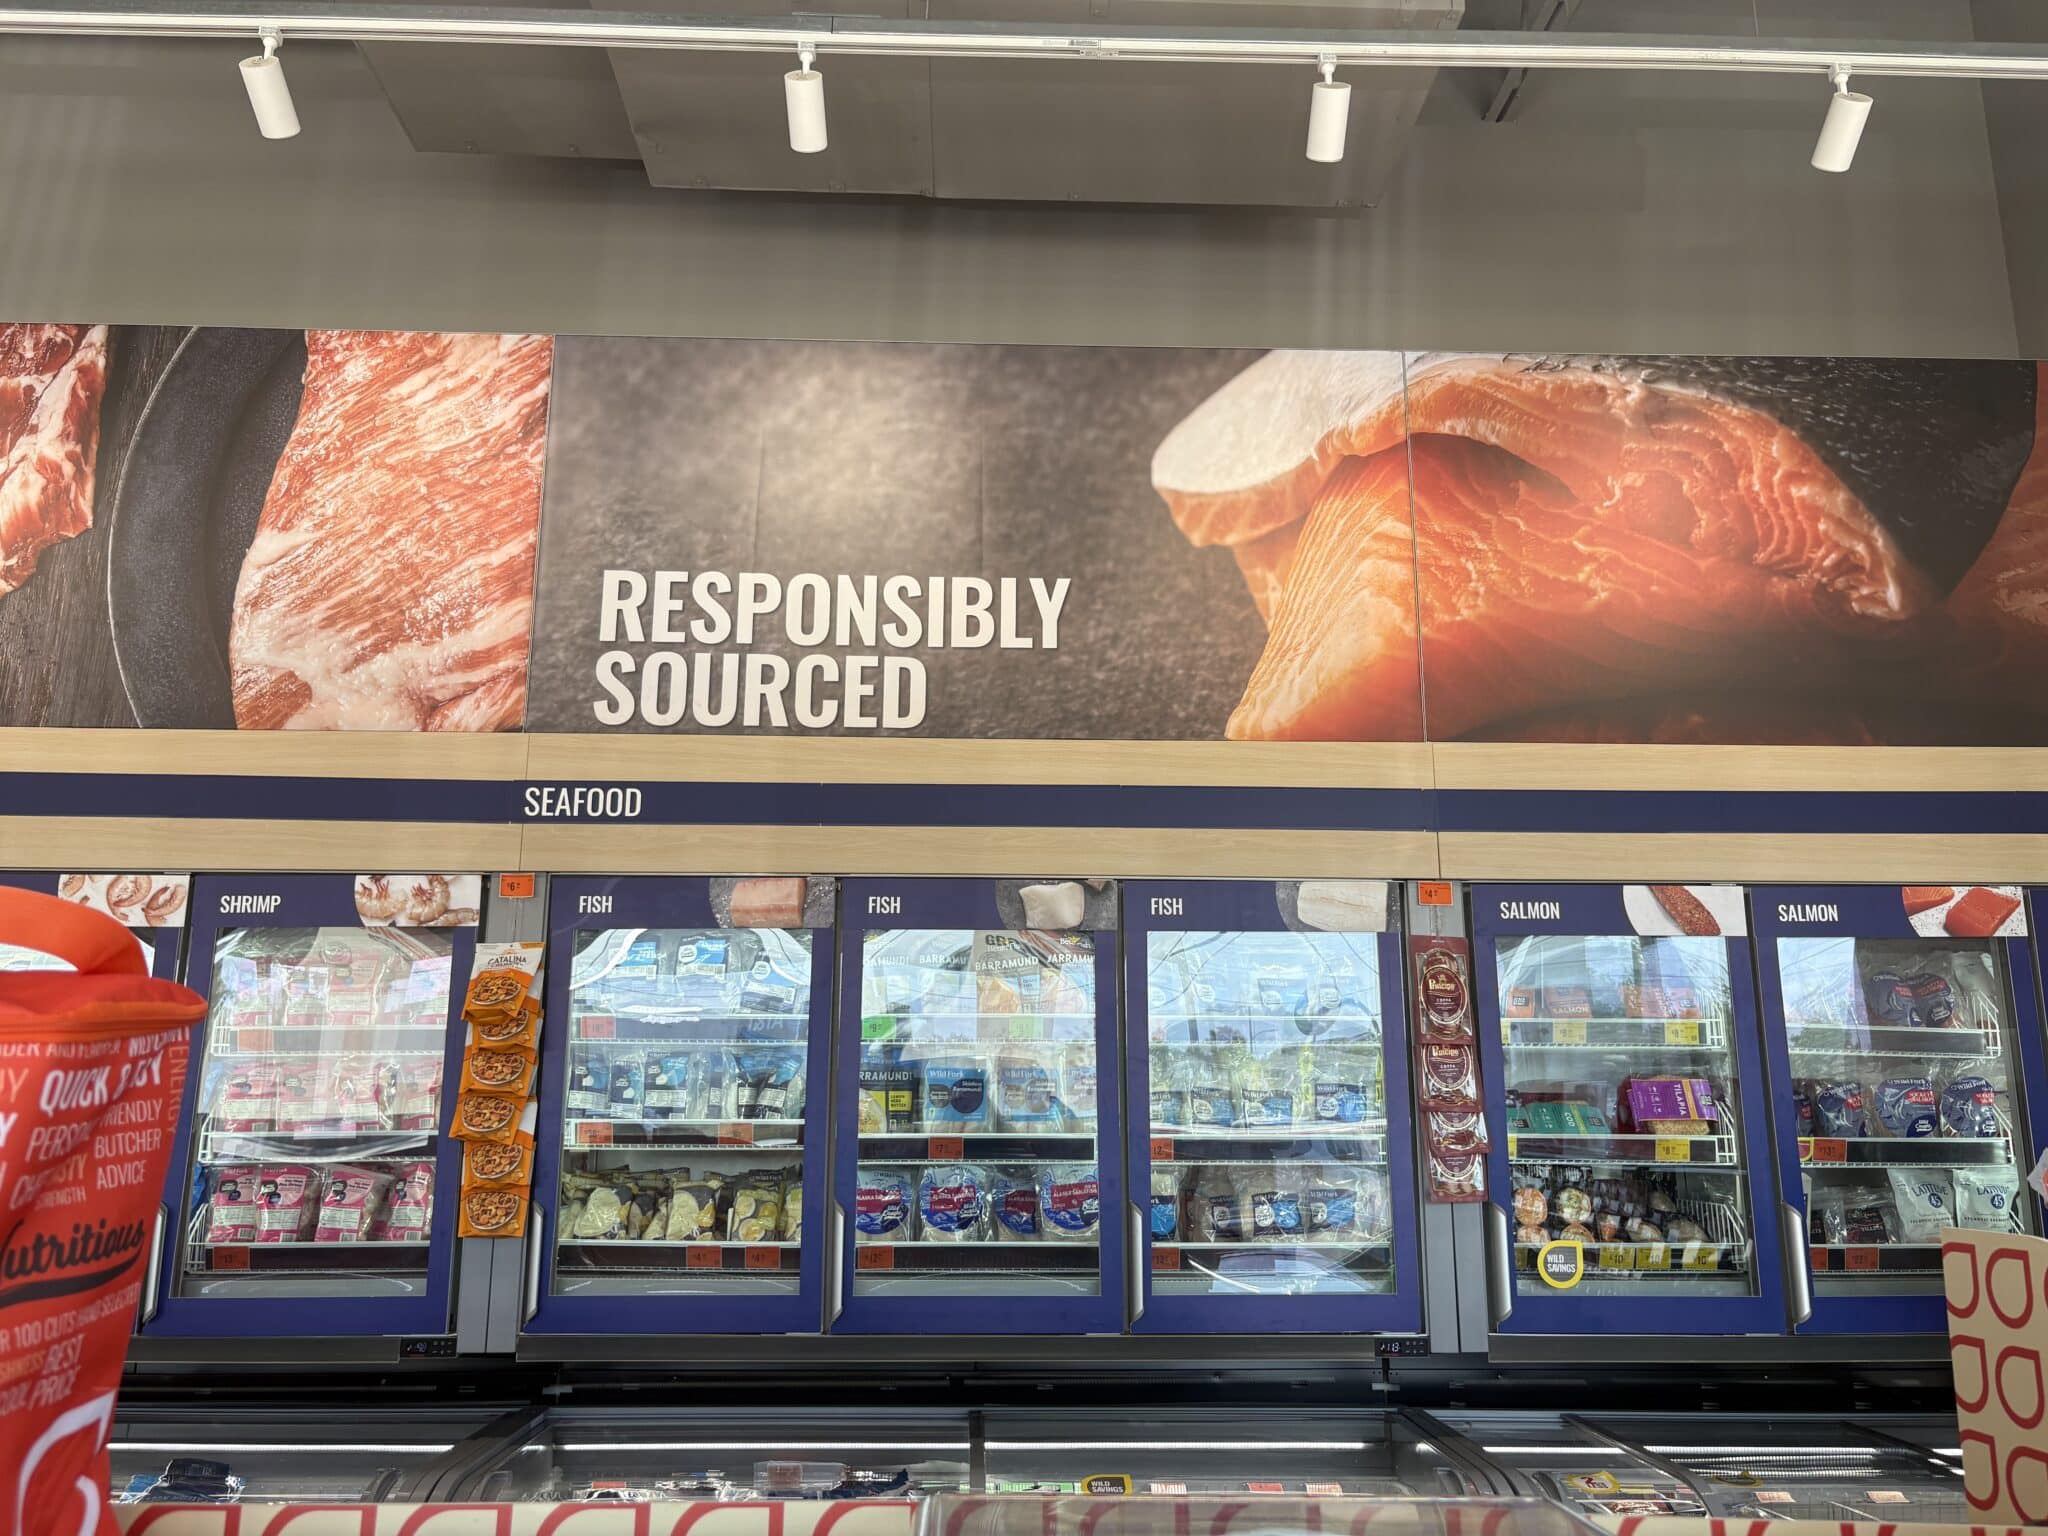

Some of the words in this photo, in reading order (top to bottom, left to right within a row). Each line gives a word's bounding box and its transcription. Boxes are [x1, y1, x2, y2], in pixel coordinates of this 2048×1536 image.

[599, 569, 1071, 650] RESPONSIBLY
[593, 650, 928, 729] SOURCED
[524, 787, 642, 817] SEAFOOD
[220, 895, 281, 913] SHRIMP
[579, 896, 613, 913] FISH
[868, 896, 901, 914] FISH
[1150, 897, 1183, 916] FISH
[1500, 901, 1560, 920] SALMON
[1778, 904, 1839, 922] SALMON
[38, 1065, 112, 1118] QUICK
[1673, 1083, 1688, 1116] TILAPIA
[94, 1128, 162, 1158] BUTCHER
[97, 1160, 147, 1189] ADVICE
[1929, 1194, 1941, 1206] 45
[1992, 1194, 2004, 1207] 45
[1547, 1255, 1565, 1263] WILD
[1547, 1263, 1576, 1273] SAVINGS
